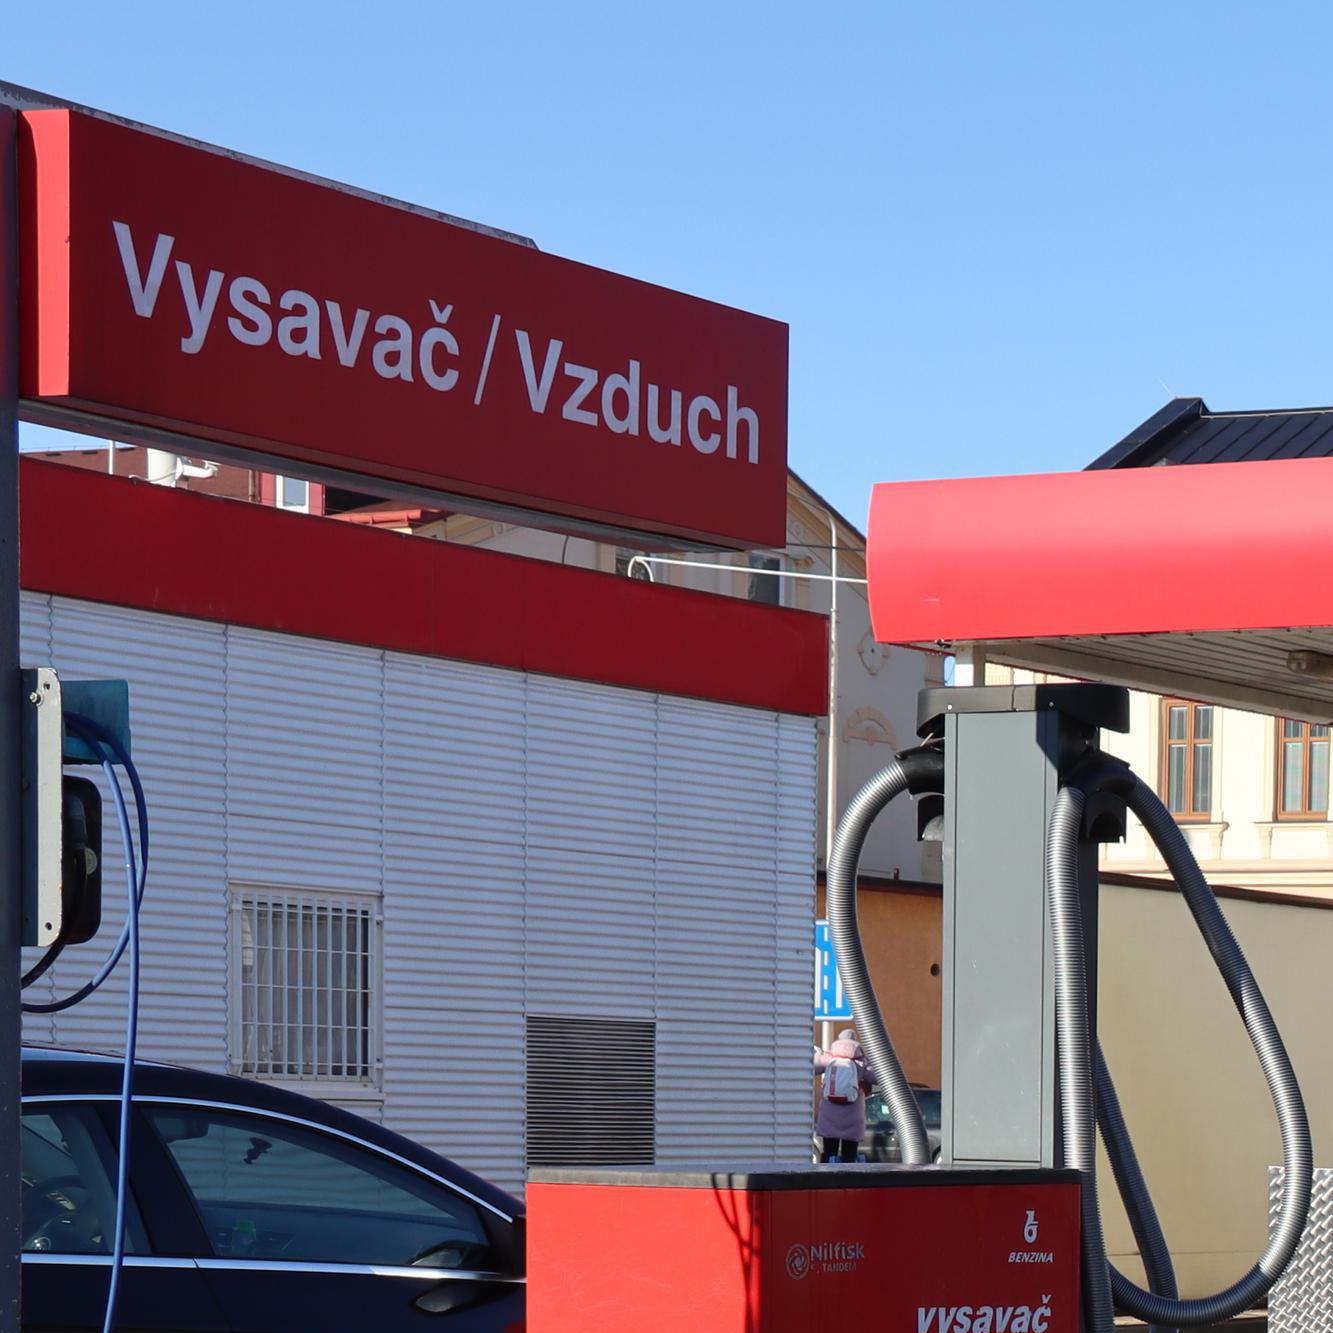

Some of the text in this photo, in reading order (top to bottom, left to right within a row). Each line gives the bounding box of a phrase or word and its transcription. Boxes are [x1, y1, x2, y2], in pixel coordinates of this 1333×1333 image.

[111, 220, 461, 392] Vysavač
[514, 329, 760, 465] Vzduch
[810, 1241, 865, 1262] Nilfisk
[1008, 1252, 1054, 1263] BENZINA
